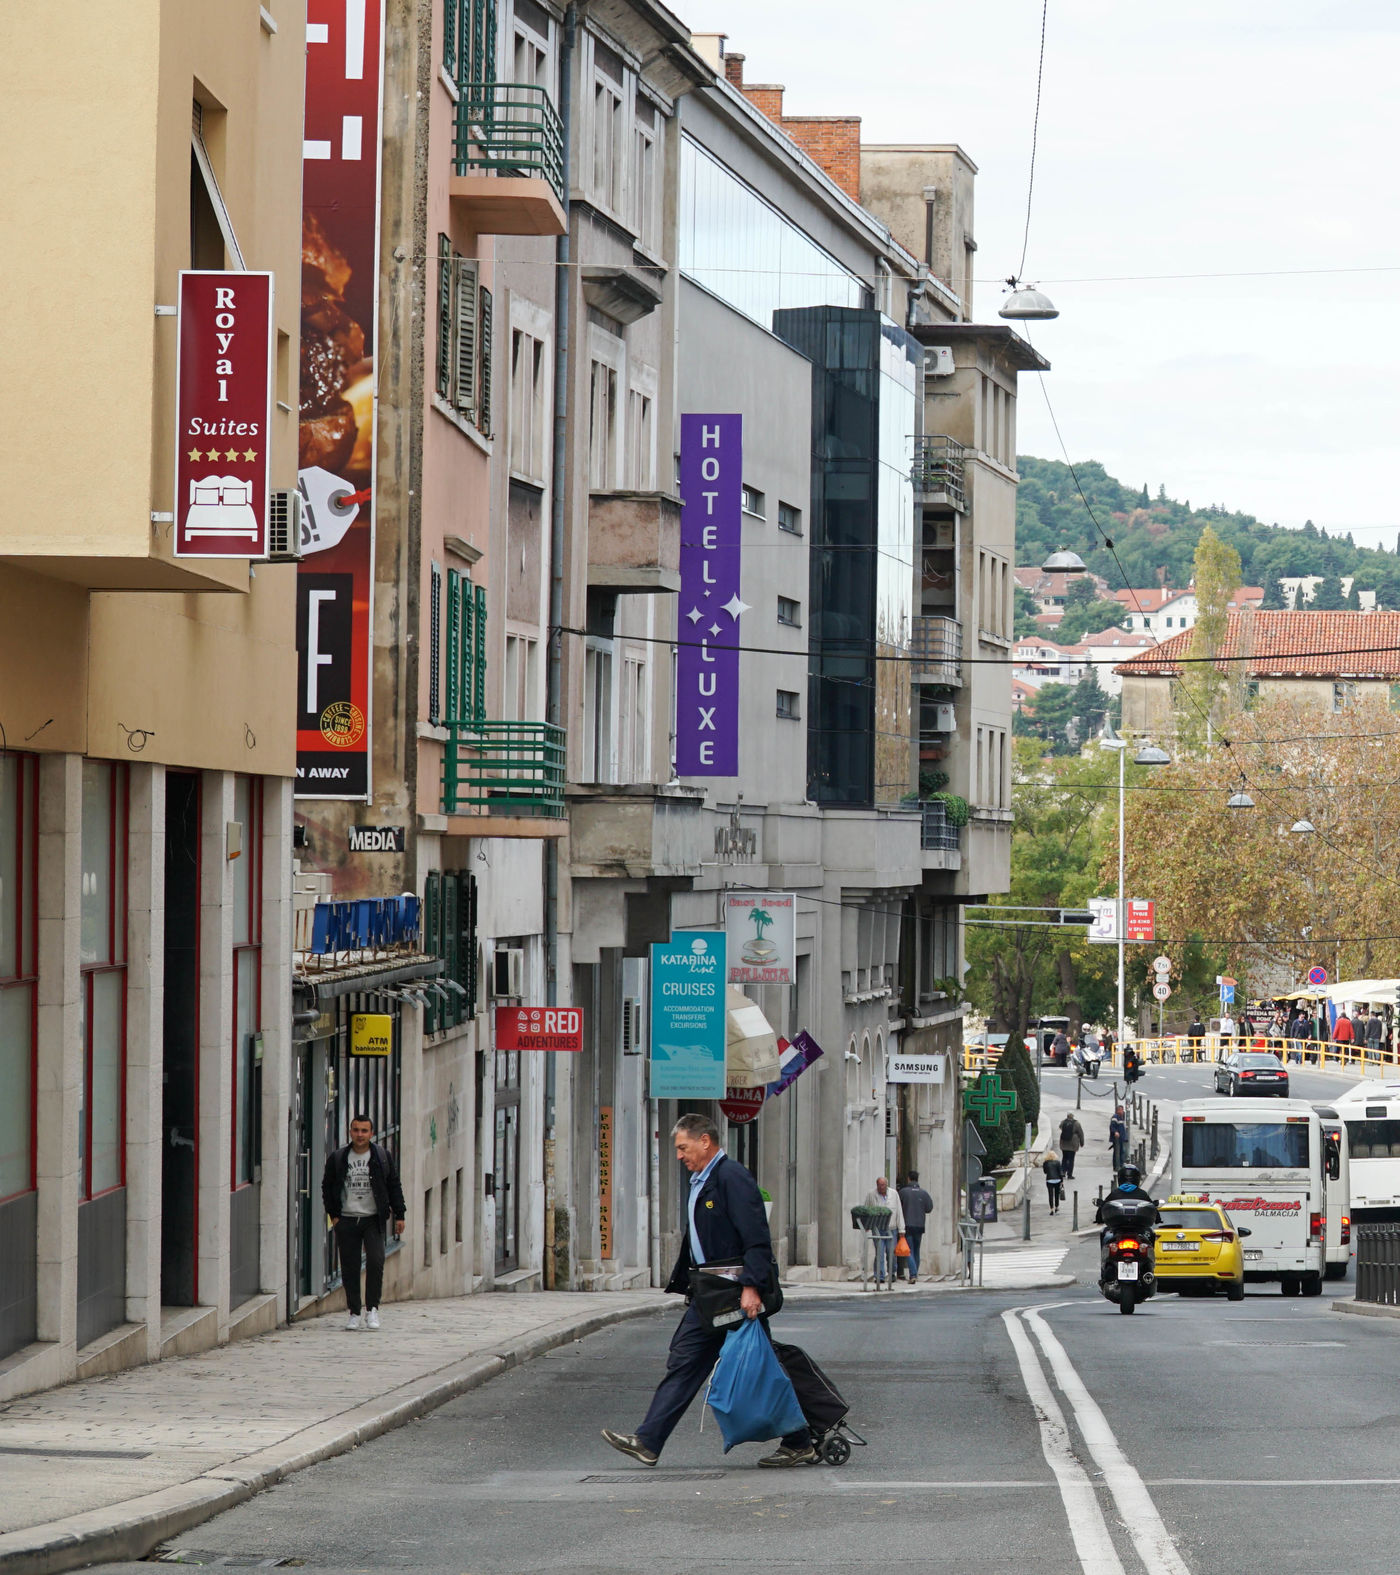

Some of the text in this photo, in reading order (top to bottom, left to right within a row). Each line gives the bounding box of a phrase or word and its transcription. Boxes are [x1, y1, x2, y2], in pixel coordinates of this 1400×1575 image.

[215, 288, 236, 402] Royal
[188, 417, 259, 436] Suites
[701, 425, 720, 585] HOTEL
[698, 638, 717, 765] LUXE
[309, 767, 349, 779] AWAY
[350, 831, 397, 851] MEDIA
[729, 898, 792, 907] fast food
[661, 954, 717, 965] KATARINA
[731, 967, 790, 982] PALMA
[662, 982, 715, 996] CRUISES
[1157, 987, 1167, 995] 40
[664, 1005, 715, 1013] ACCOMMODATION
[544, 1010, 579, 1034] RED
[672, 1013, 706, 1021] TRANSFERS
[670, 1021, 707, 1029] EXCURSIONS
[368, 1037, 389, 1046] ATM
[517, 1035, 578, 1050] ADVENTURES
[894, 1062, 939, 1072] SAMSUNG
[728, 1087, 763, 1102] ALMA
[600, 1205, 608, 1251] SALON
